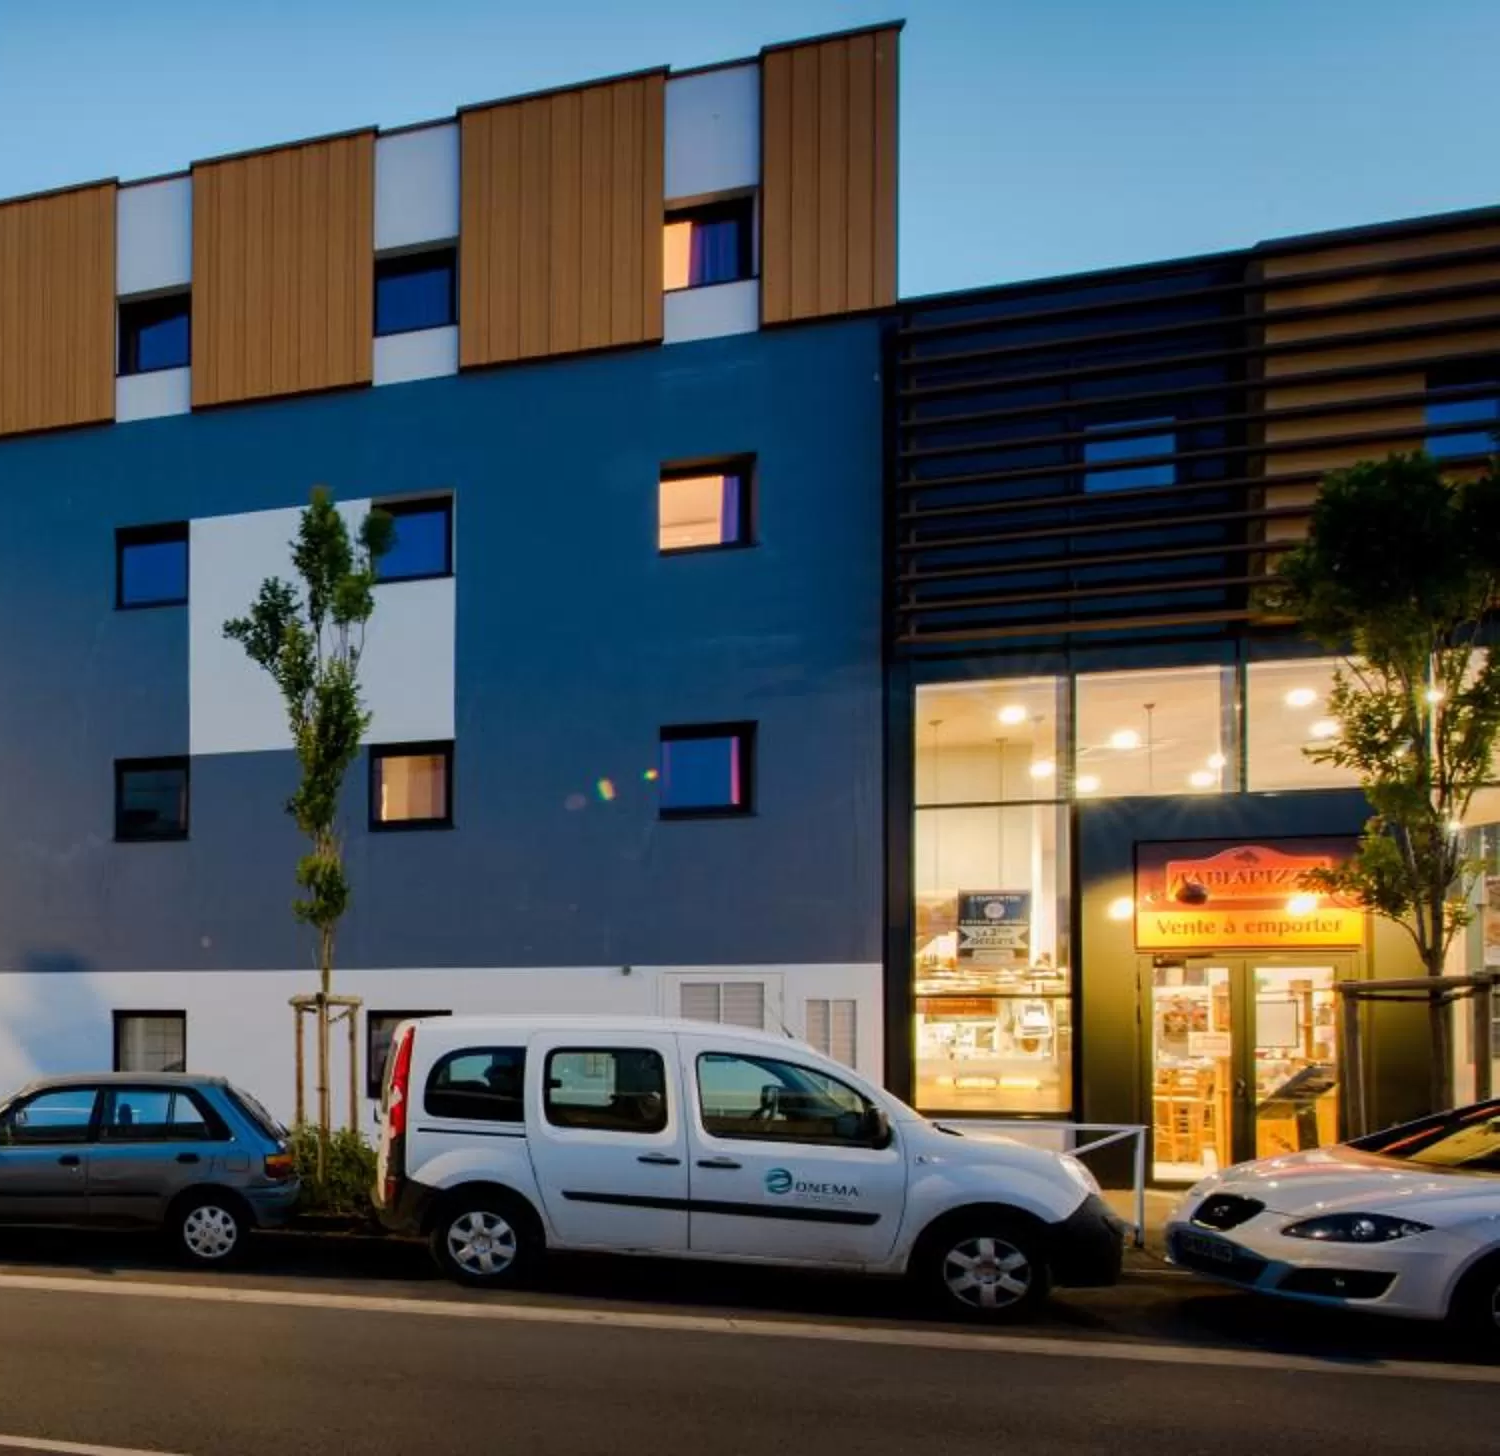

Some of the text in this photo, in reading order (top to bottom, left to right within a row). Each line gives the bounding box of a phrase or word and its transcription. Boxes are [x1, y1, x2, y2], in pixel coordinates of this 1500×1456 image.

[1173, 866, 1324, 887] TABLAPIZZ
[1156, 915, 1343, 937] Vente à emporter
[795, 1181, 860, 1197] ONEMA
